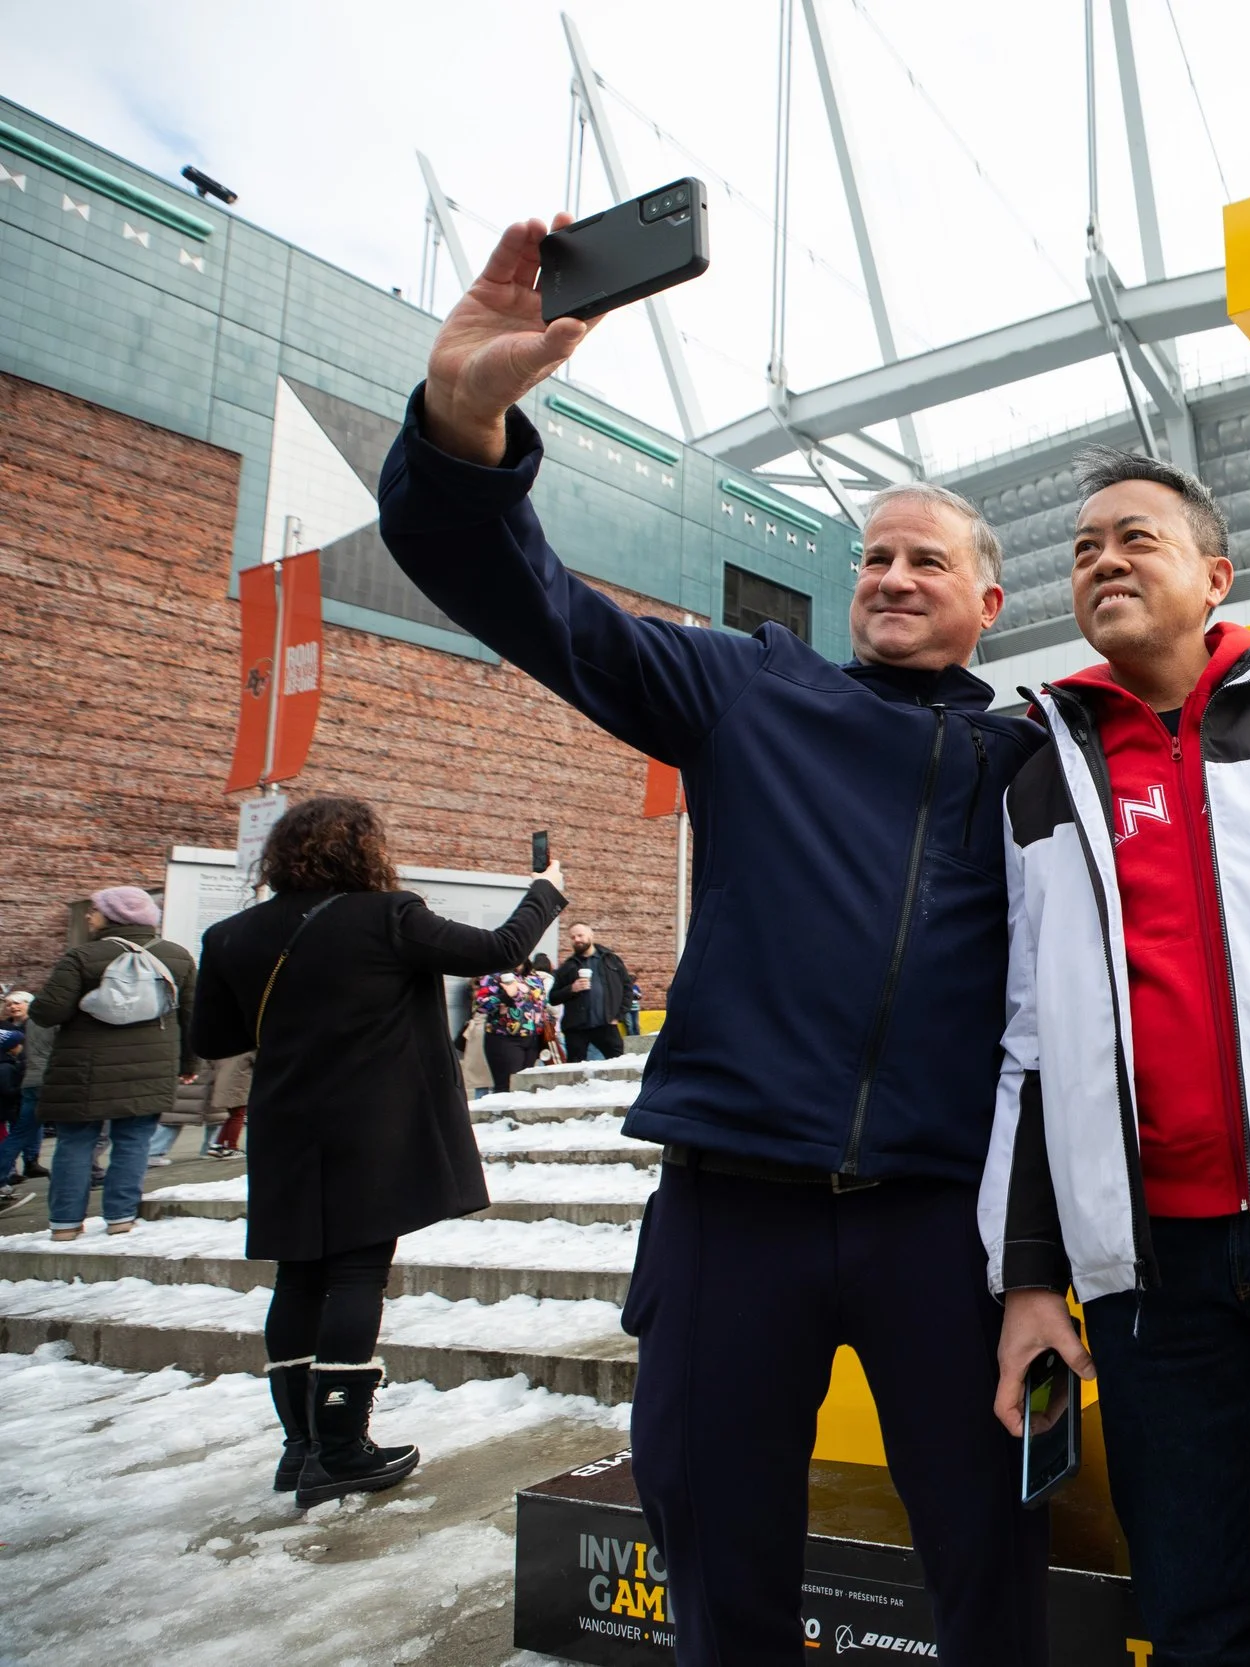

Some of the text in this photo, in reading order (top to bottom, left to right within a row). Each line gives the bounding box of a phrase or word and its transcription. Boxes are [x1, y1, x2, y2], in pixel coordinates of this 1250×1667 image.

[834, 1588, 844, 1598] BY
[848, 1590, 888, 1605] PRÉSENTÉS
[890, 1597, 904, 1607] PAR
[579, 1615, 676, 1648] VANCOUVER WHI
